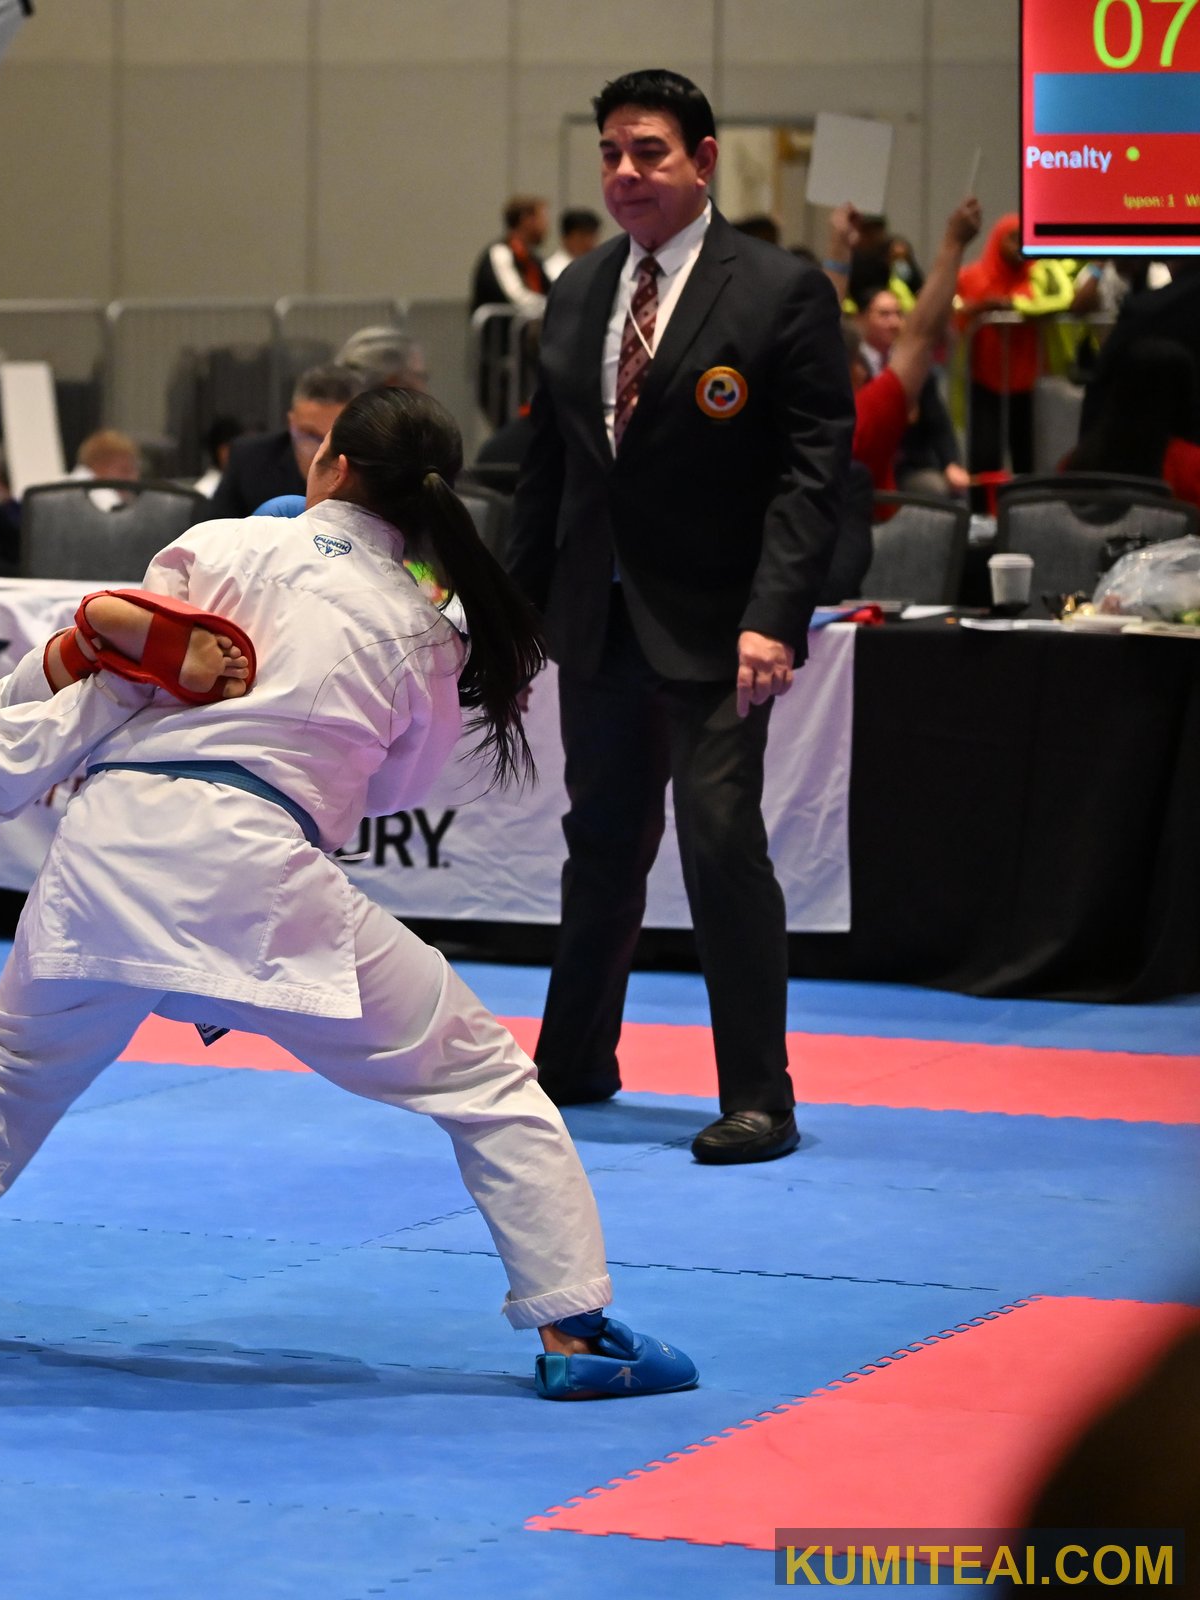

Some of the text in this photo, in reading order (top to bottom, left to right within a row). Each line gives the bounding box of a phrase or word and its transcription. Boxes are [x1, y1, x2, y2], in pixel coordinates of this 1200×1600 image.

[1093, 0, 1198, 69] 07
[1025, 144, 1112, 173] Penalty
[1168, 194, 1175, 208] 1
